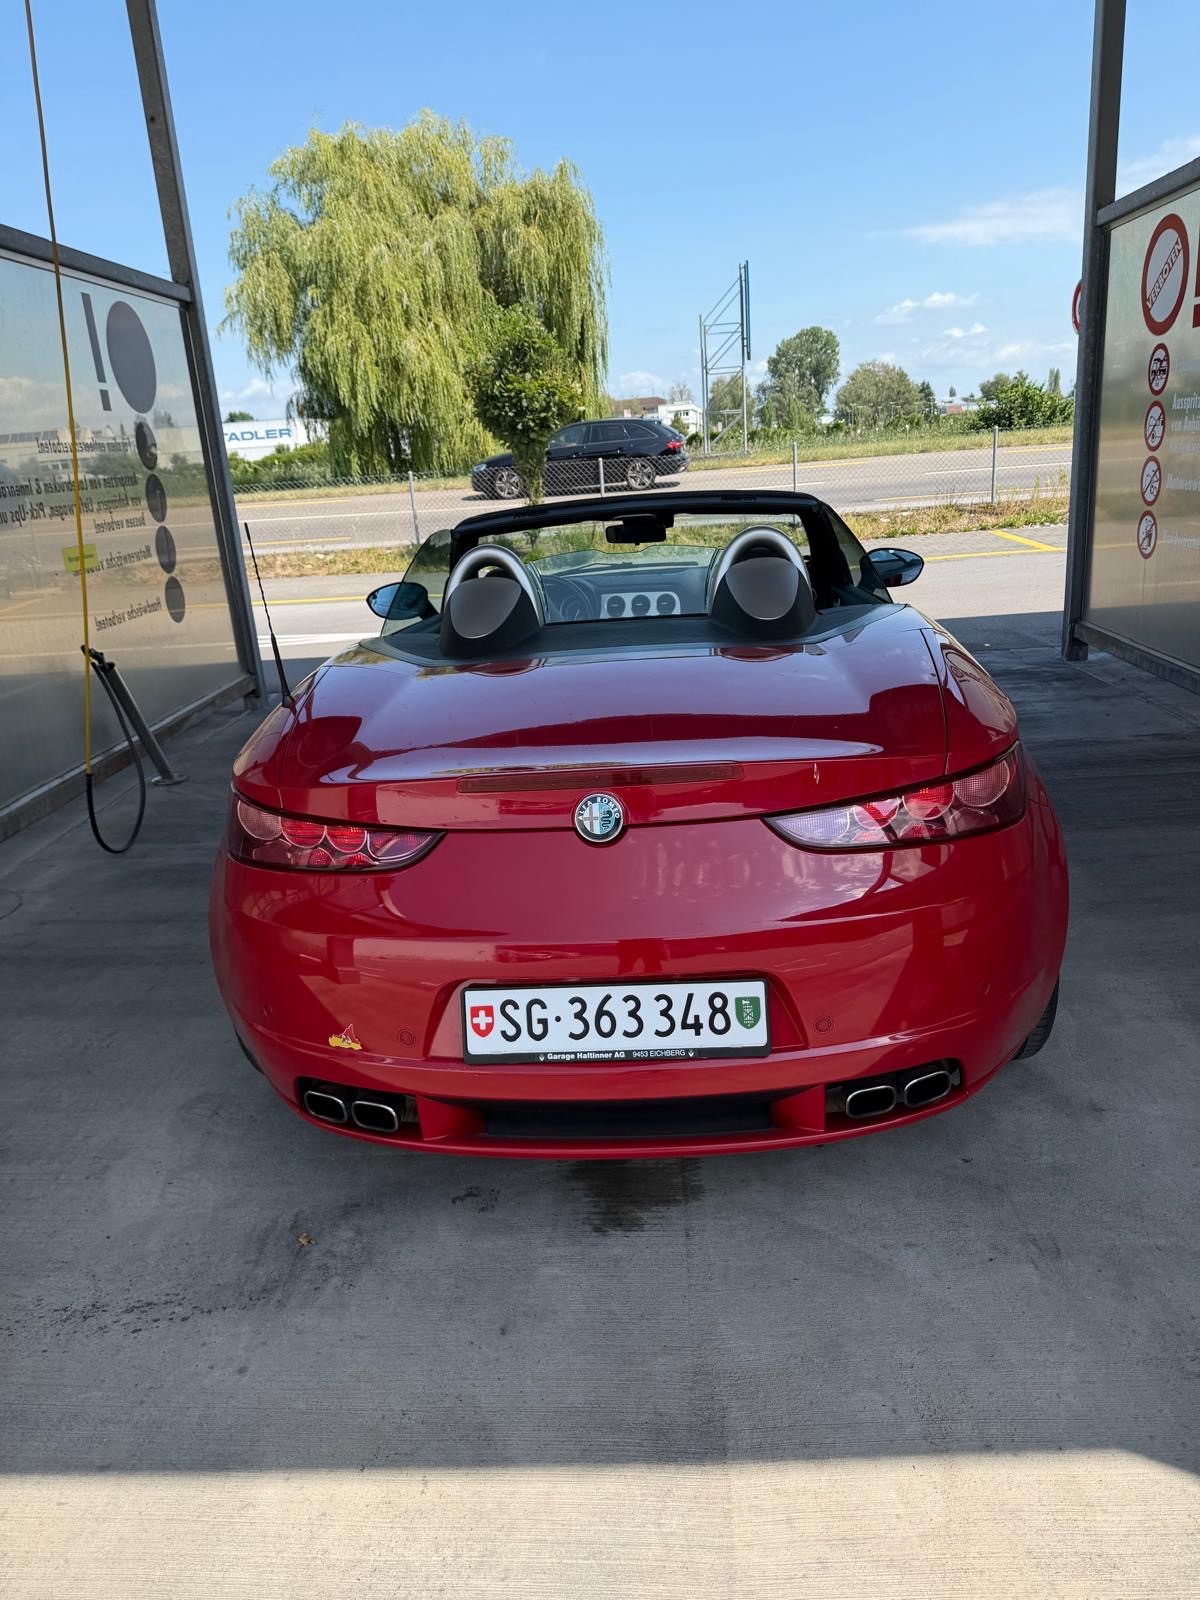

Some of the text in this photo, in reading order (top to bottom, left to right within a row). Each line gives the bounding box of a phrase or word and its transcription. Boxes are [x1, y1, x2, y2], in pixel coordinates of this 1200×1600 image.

[1146, 237, 1183, 309] VERBOTEN
[223, 428, 292, 442] ADLER
[577, 797, 620, 820] ALFA ROMEO
[649, 1050, 686, 1058] EICHBERG
